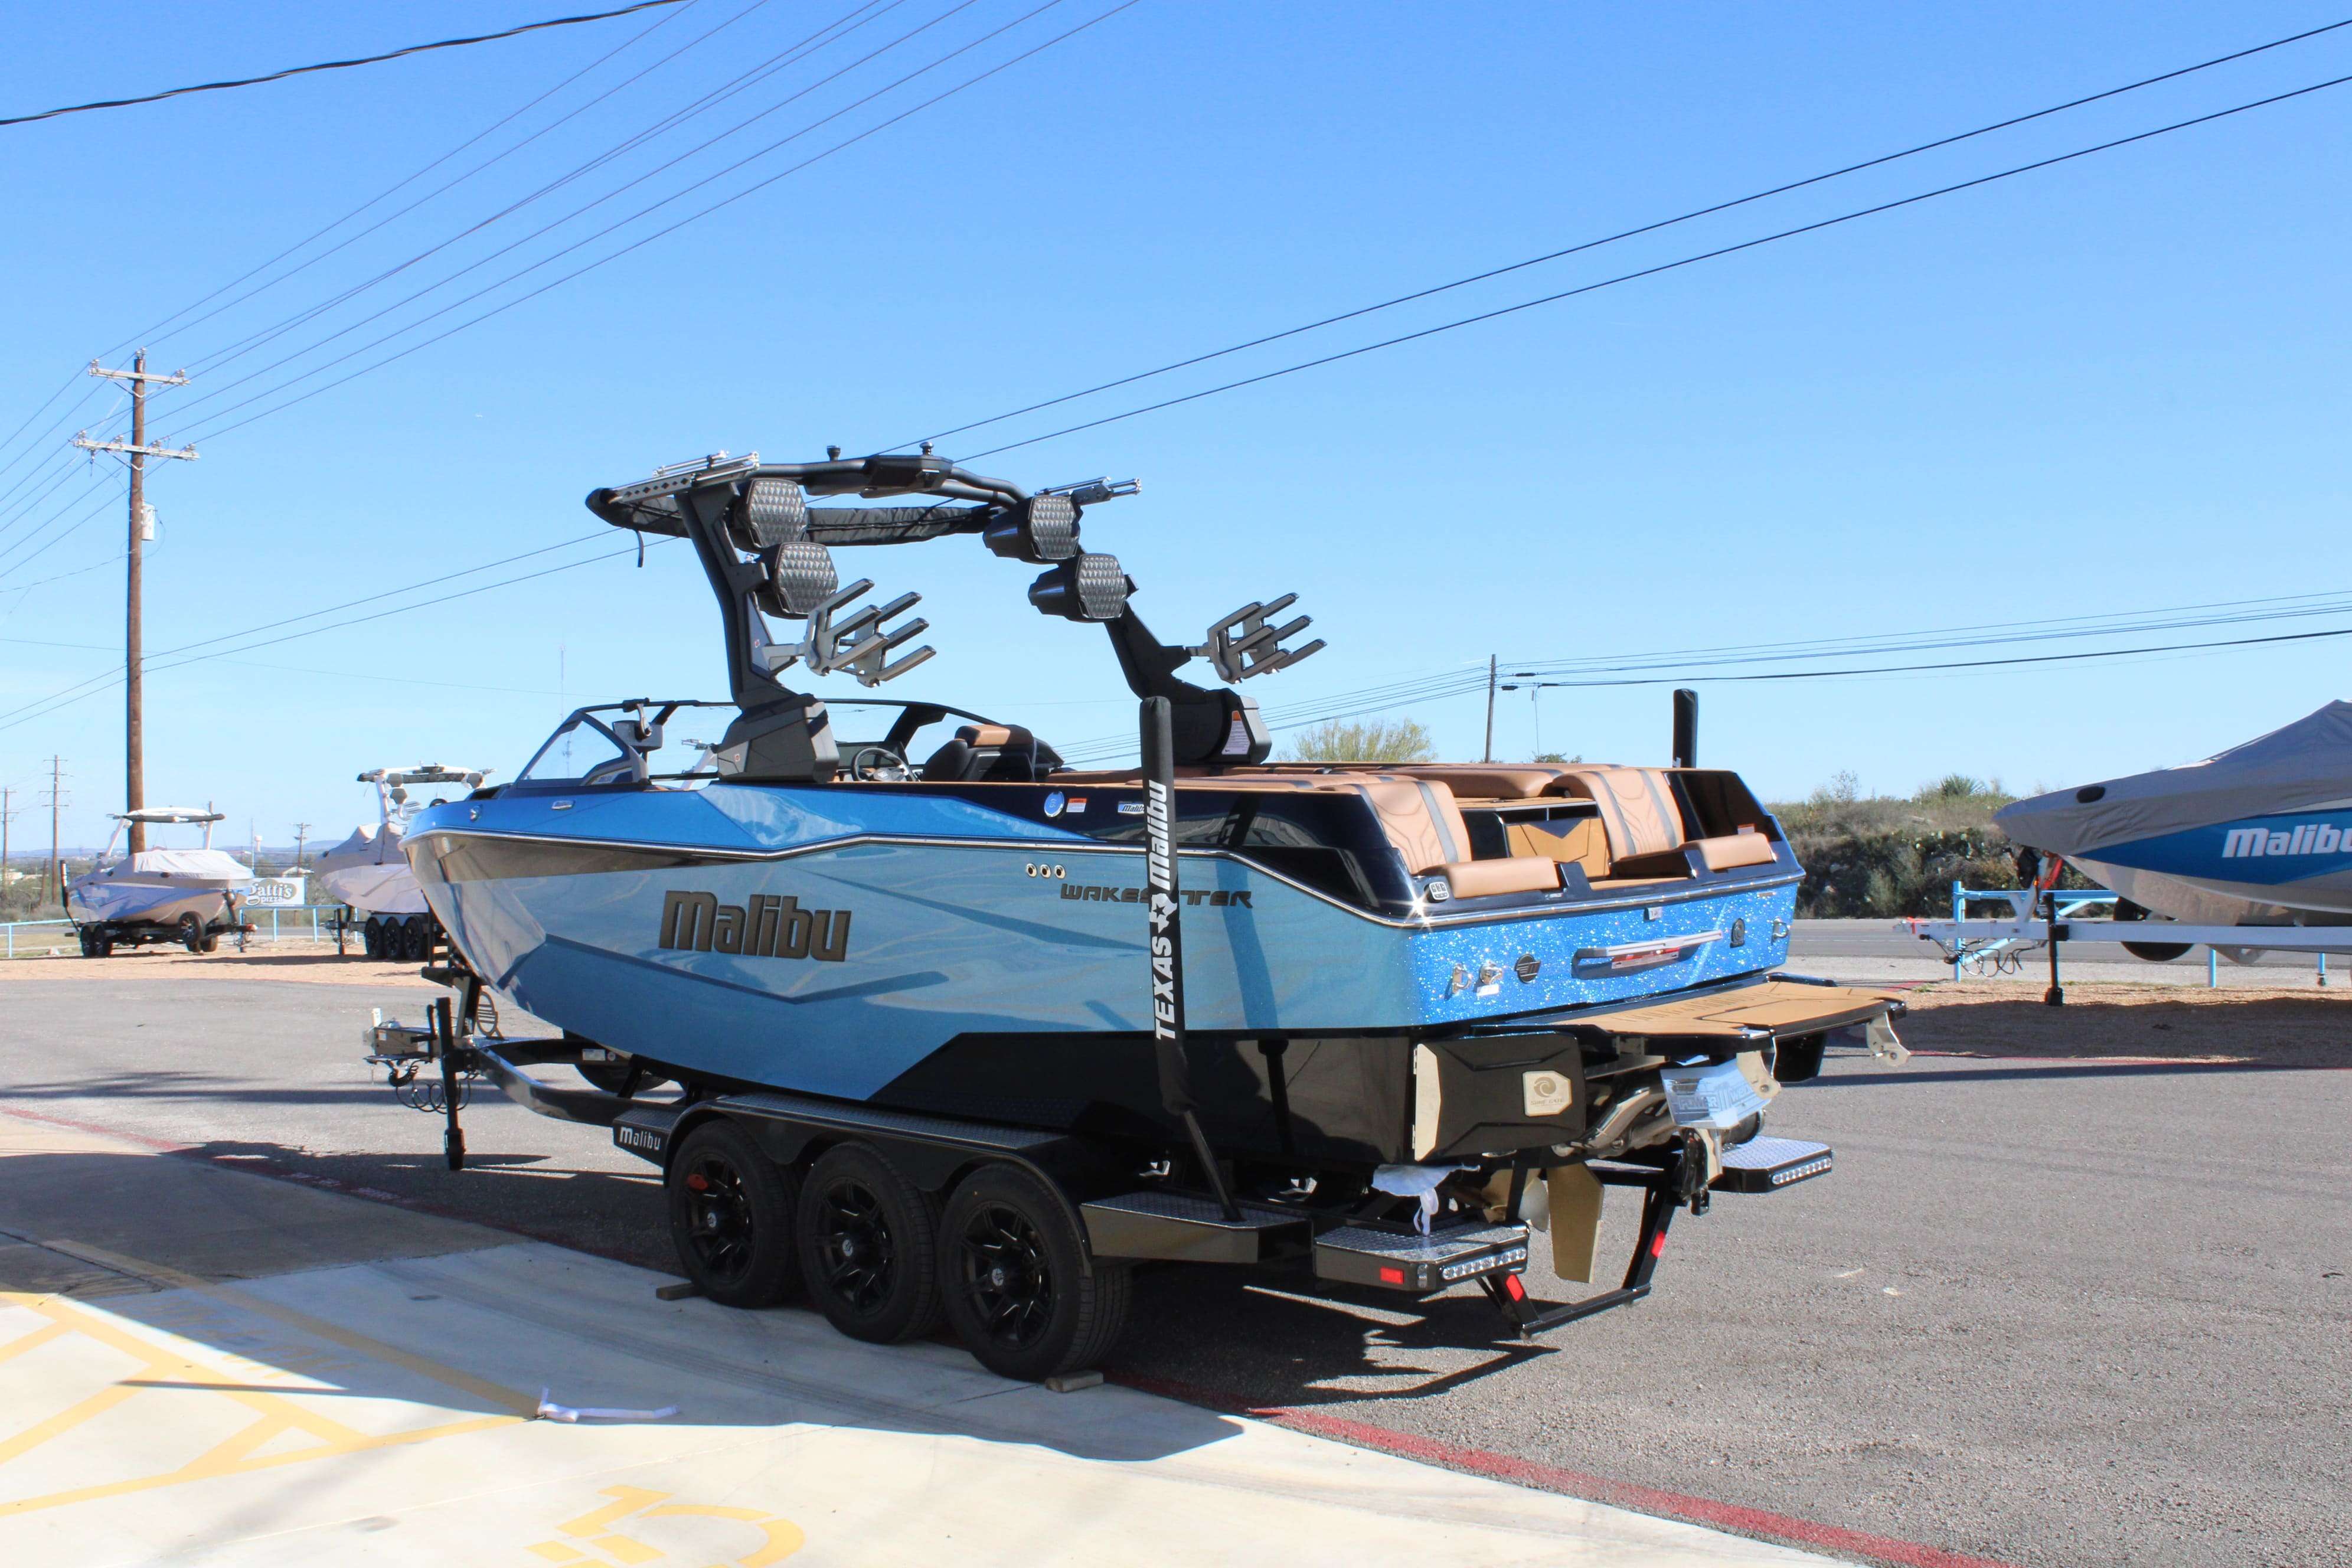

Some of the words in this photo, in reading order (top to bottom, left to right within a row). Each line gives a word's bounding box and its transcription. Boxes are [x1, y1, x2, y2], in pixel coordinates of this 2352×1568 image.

[1147, 779, 1171, 891] Malibu
[658, 890, 851, 962] Malibu
[1151, 936, 1175, 1040] TEXAS
[619, 1126, 661, 1151] Malibu
